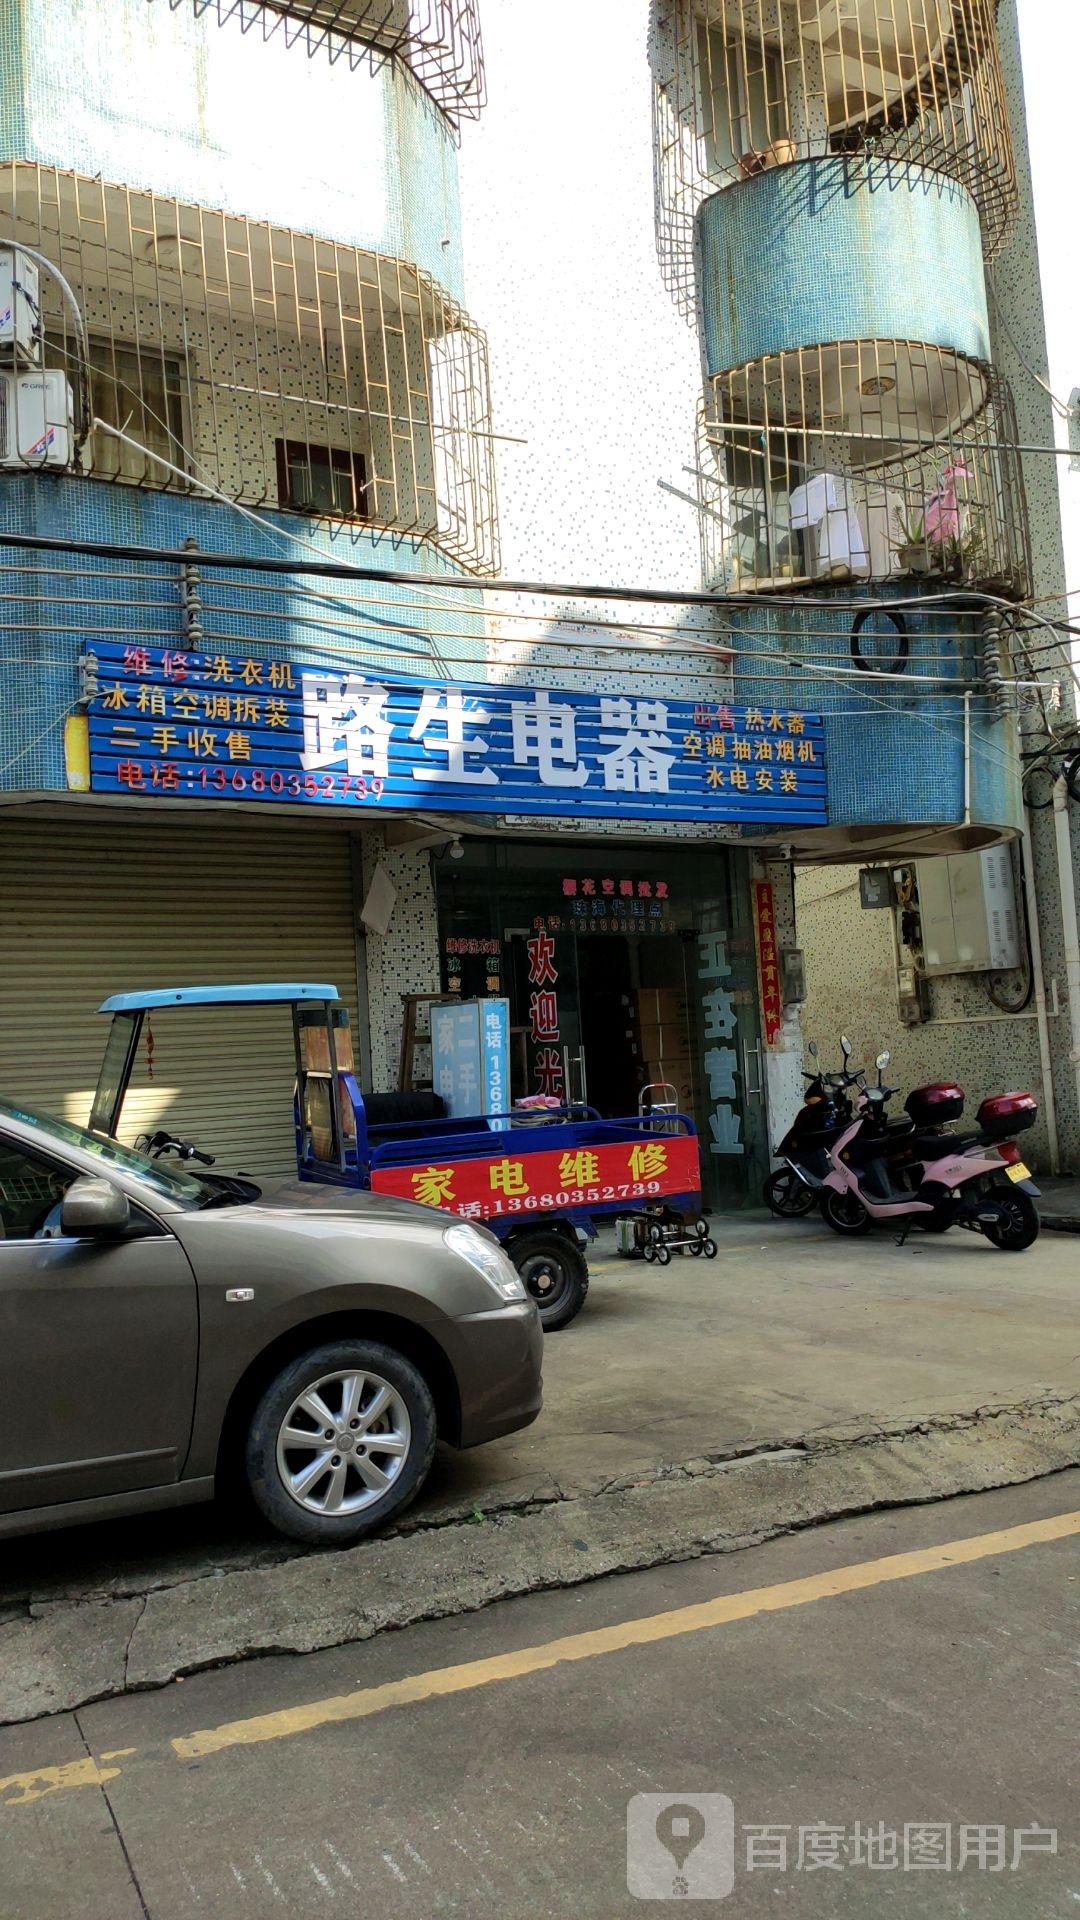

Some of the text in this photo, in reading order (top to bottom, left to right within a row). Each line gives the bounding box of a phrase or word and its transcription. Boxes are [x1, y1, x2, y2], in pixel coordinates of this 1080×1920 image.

[110, 726, 252, 761] 二手收售
[299, 672, 676, 794] 路生电器
[682, 734, 817, 763] 空调抽油烟机
[706, 766, 798, 793] 水电安装
[410, 1143, 669, 1207] 家电维修
[440, 1181, 661, 1218] 话:13680352739
